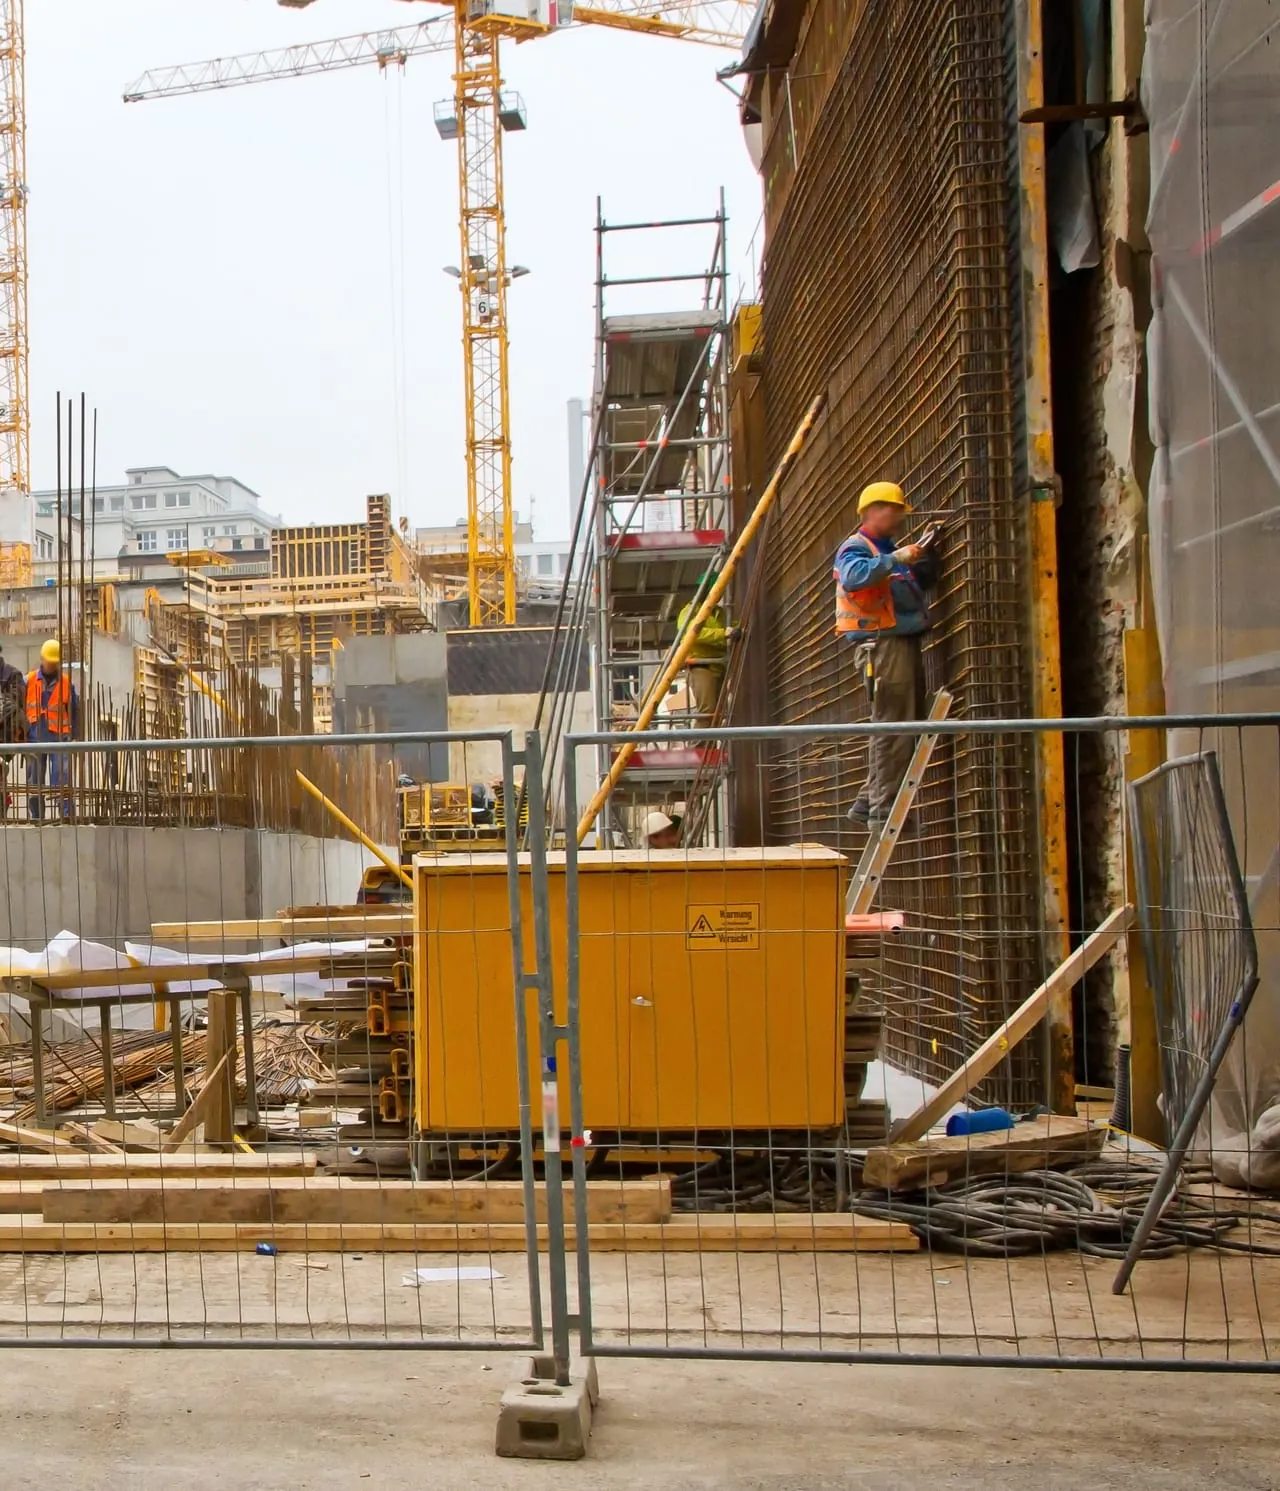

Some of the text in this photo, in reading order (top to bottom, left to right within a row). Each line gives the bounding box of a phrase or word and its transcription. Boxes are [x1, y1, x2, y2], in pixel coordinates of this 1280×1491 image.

[478, 301, 487, 314] 6
[0, 408, 6, 417] 2
[719, 910, 753, 920] Warnung
